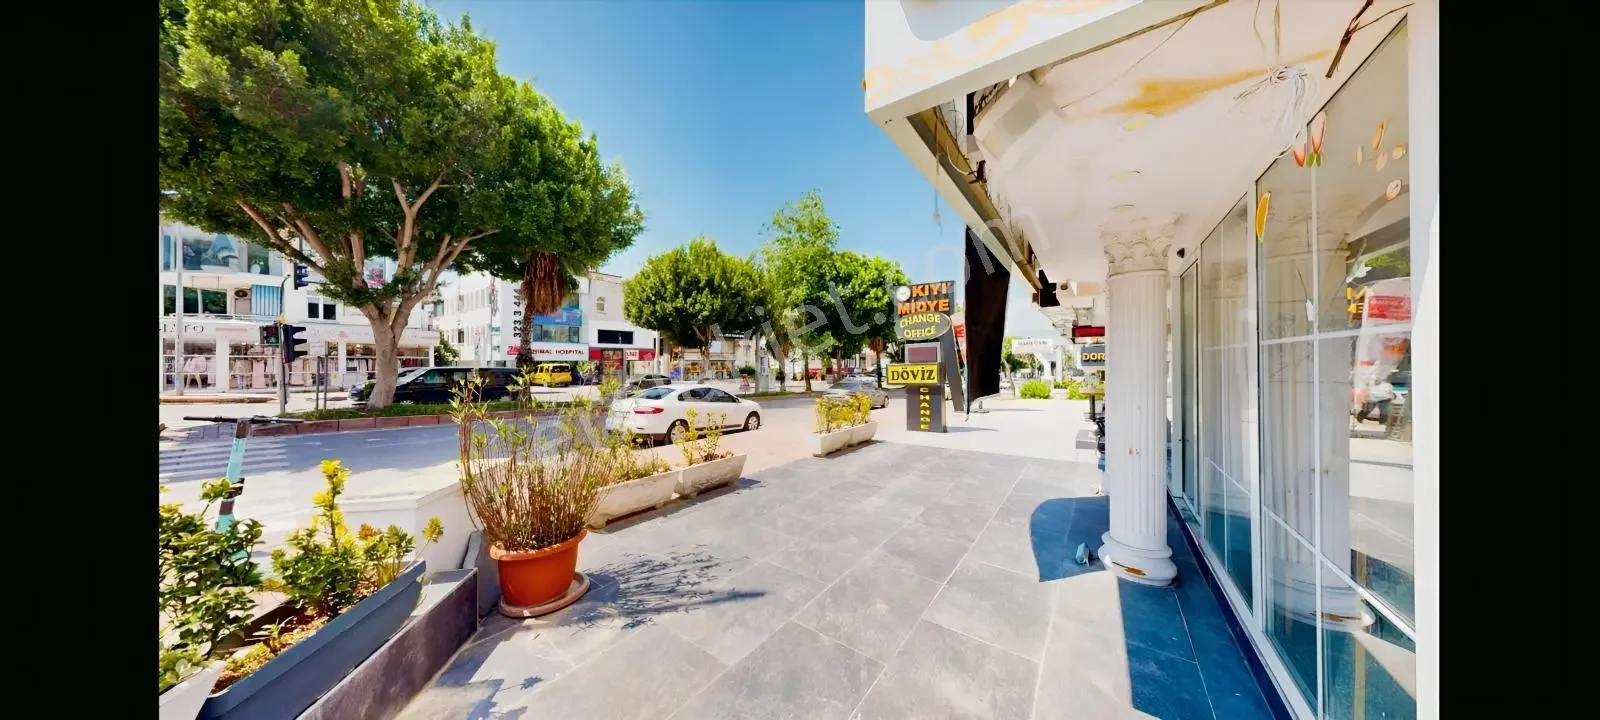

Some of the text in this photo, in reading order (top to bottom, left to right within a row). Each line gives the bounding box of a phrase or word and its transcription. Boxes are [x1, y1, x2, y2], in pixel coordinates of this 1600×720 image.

[911, 282, 947, 298] KIYI
[899, 312, 941, 328] CHANGE
[903, 325, 937, 338] OFFICE
[891, 366, 936, 382] DÖVİZ
[919, 386, 931, 430] CHANGE
